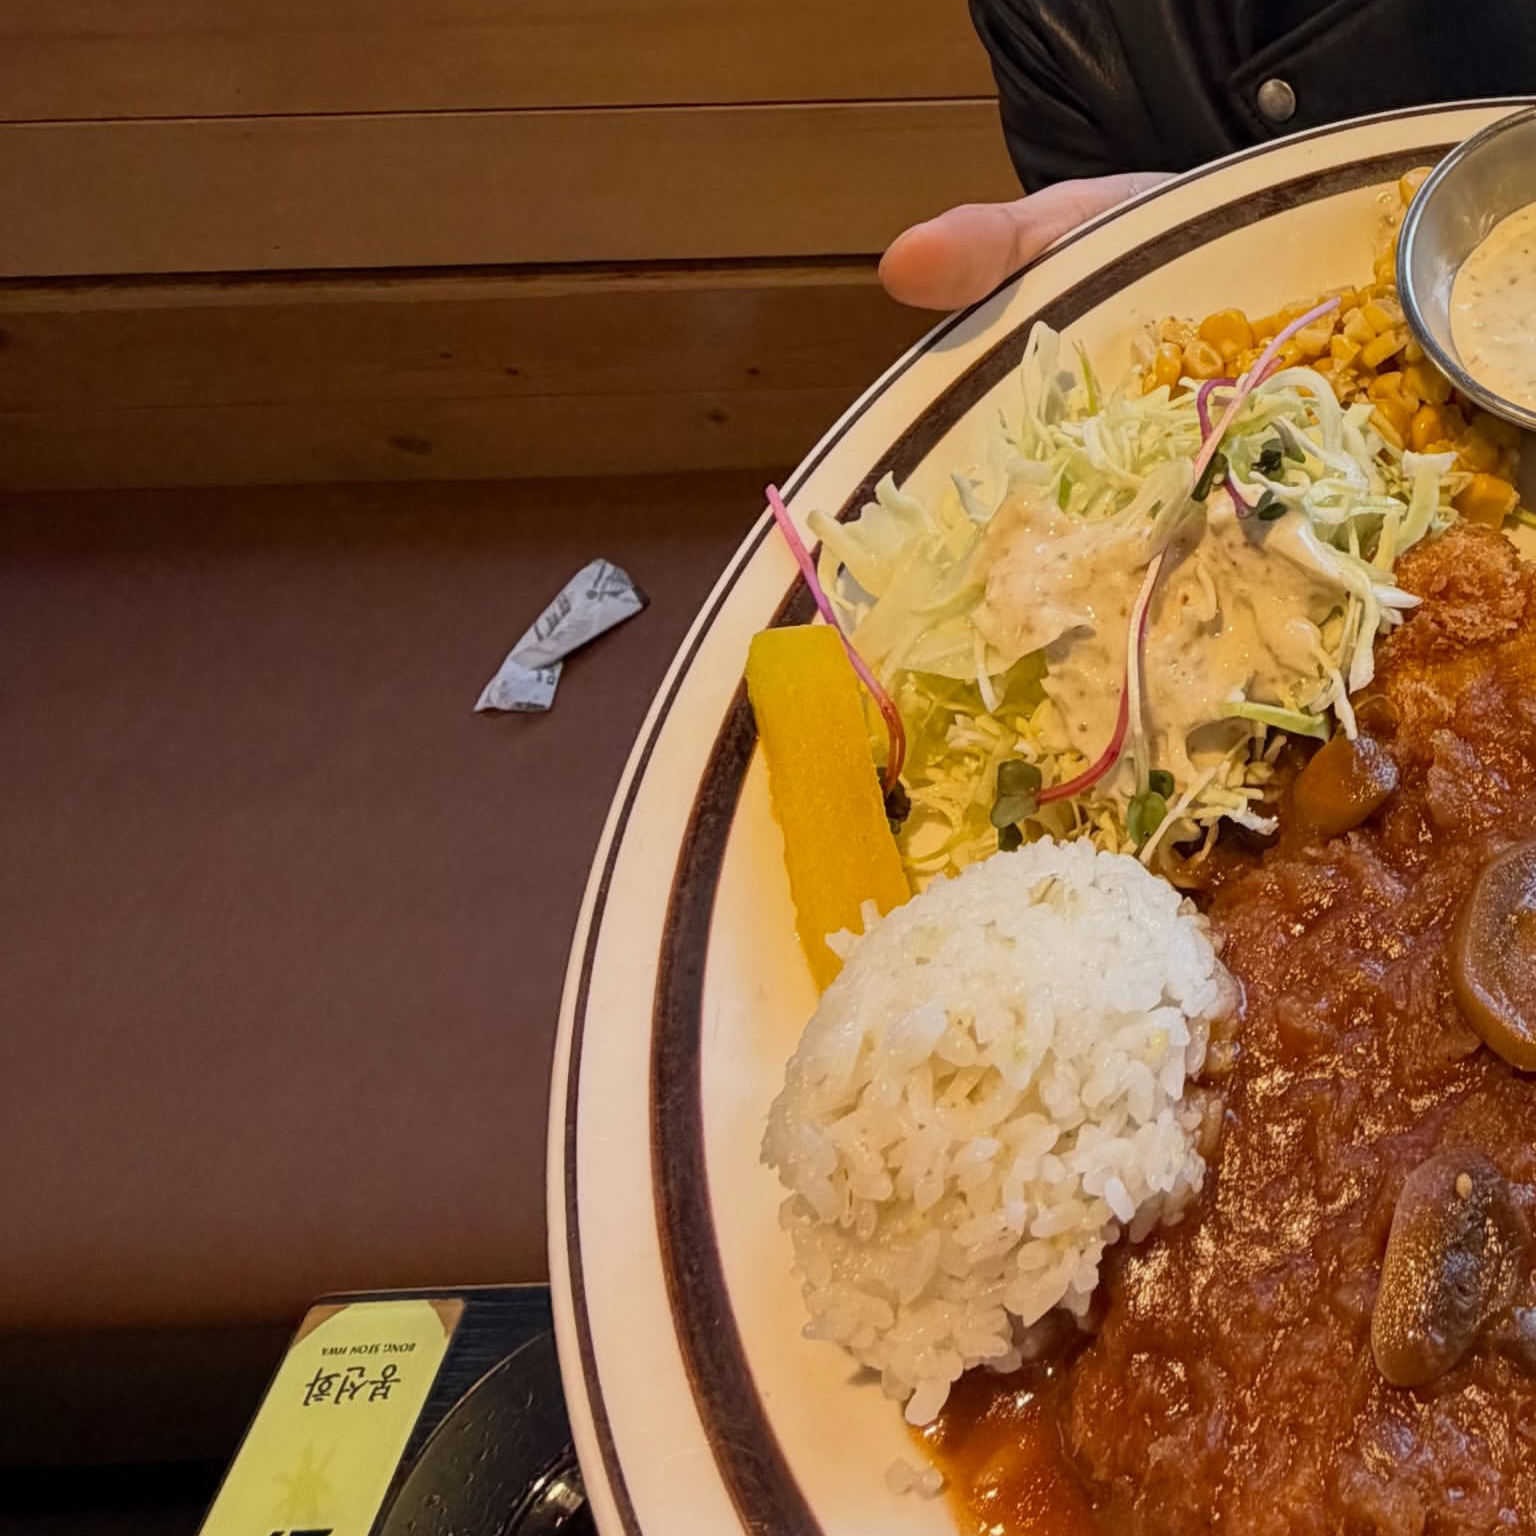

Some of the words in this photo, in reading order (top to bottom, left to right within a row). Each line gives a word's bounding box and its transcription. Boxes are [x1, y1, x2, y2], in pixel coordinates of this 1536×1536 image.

[321, 1346, 349, 1357] HWA
[349, 1344, 381, 1355] SEON
[381, 1342, 417, 1353] BONG
[303, 1364, 401, 1406] 봉선화
